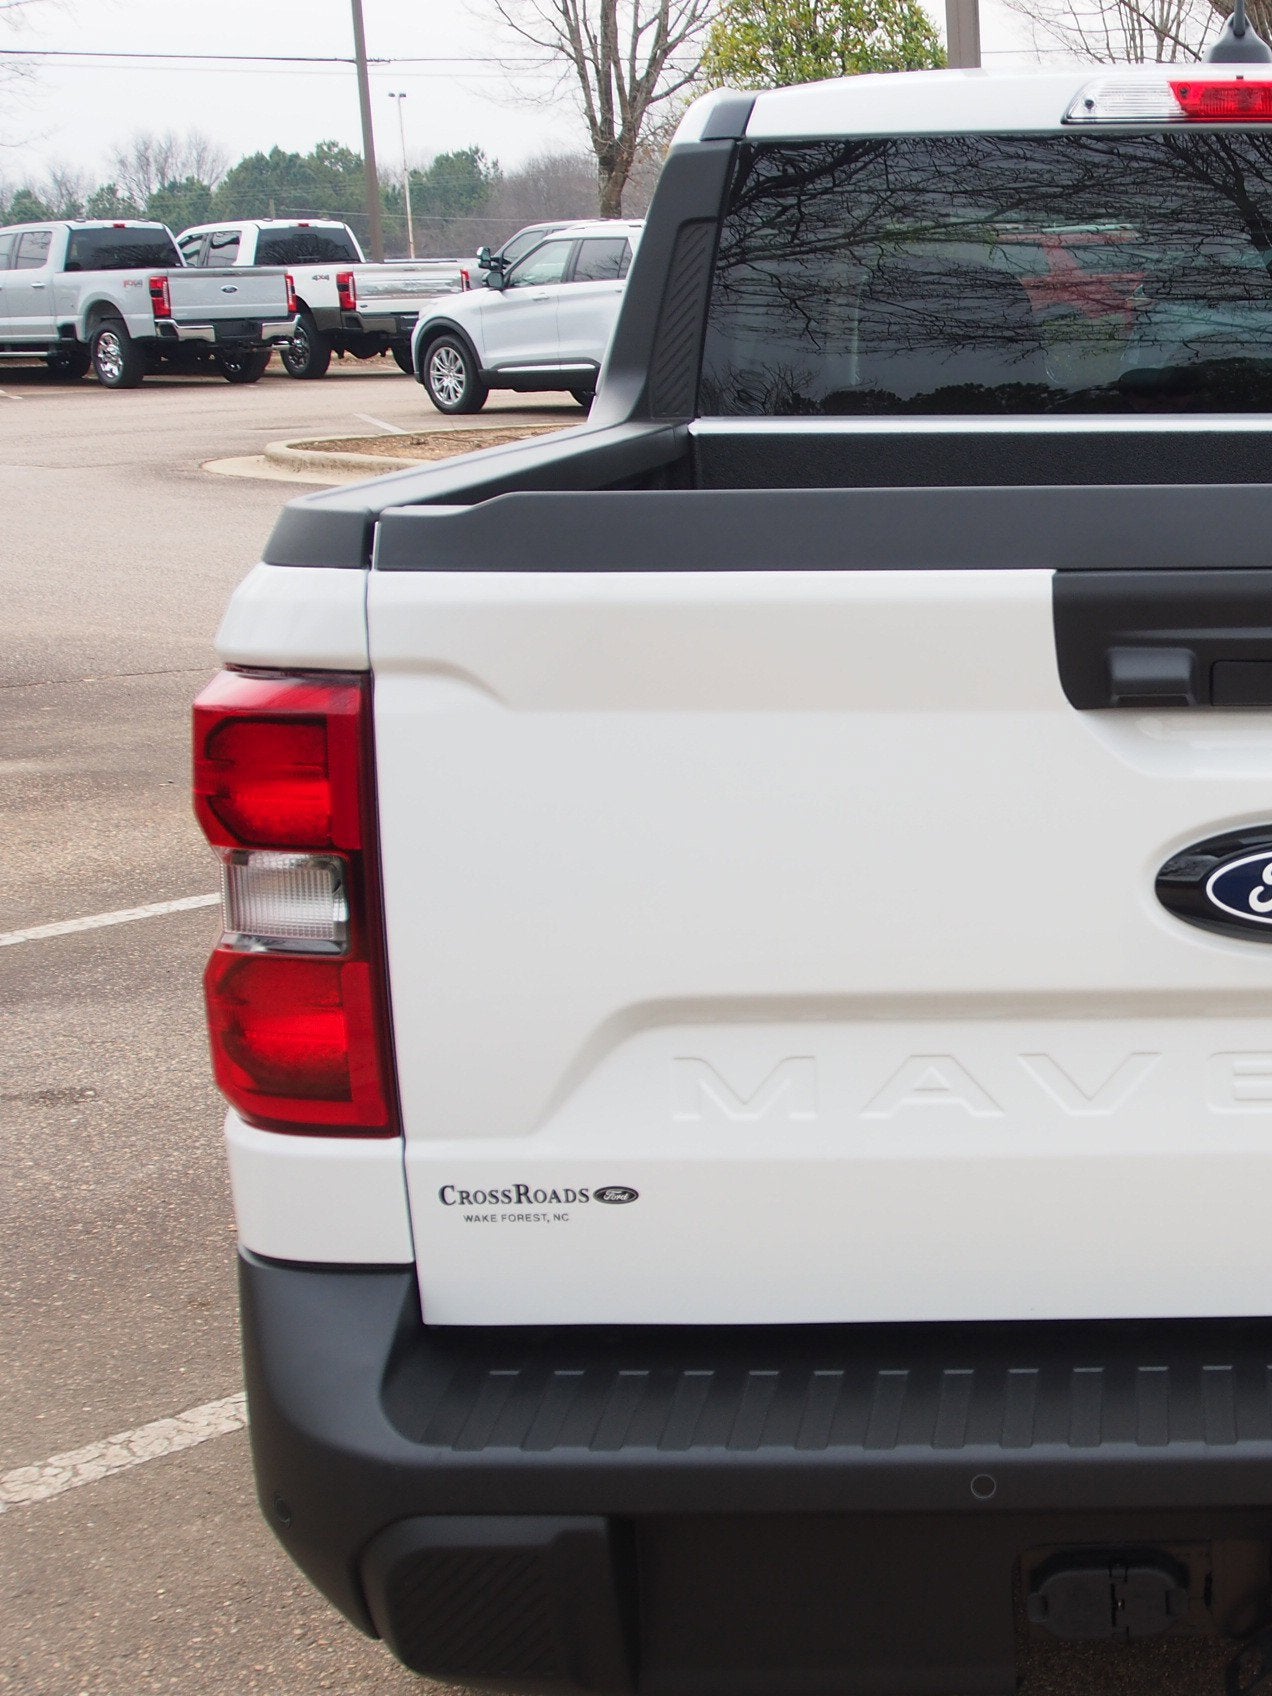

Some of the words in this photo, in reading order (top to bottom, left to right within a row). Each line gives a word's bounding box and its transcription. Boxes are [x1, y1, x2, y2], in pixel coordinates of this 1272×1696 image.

[463, 1213, 498, 1223] WAKE
[501, 1213, 550, 1223] FOREST,
[553, 1213, 569, 1222] NC
